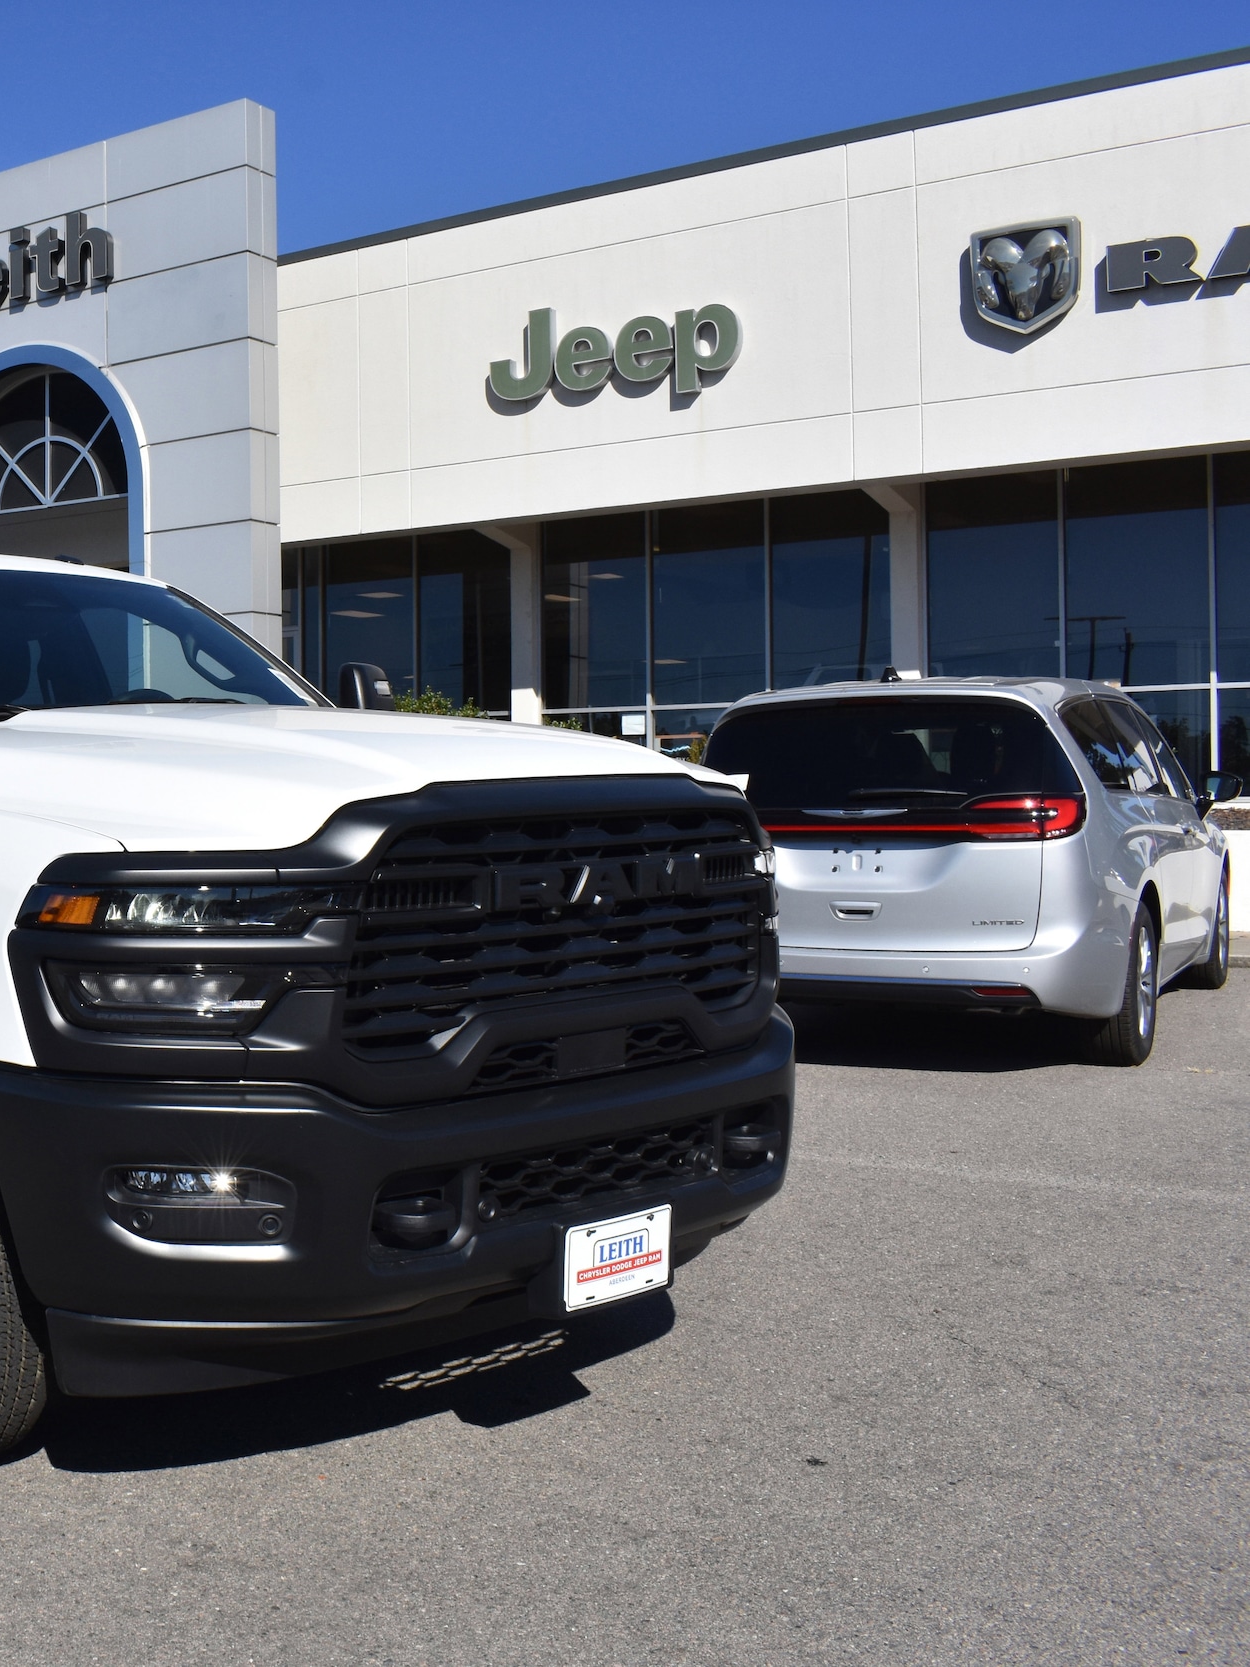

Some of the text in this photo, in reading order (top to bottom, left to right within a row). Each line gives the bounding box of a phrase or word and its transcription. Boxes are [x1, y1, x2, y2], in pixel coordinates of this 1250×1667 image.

[489, 303, 743, 400] Jeep
[498, 857, 698, 911] RAM
[599, 1235, 644, 1263] LEITH
[579, 1252, 661, 1280] CHRYSLER DODGE JEEP RAM
[609, 1273, 635, 1285] ABERDEEN
